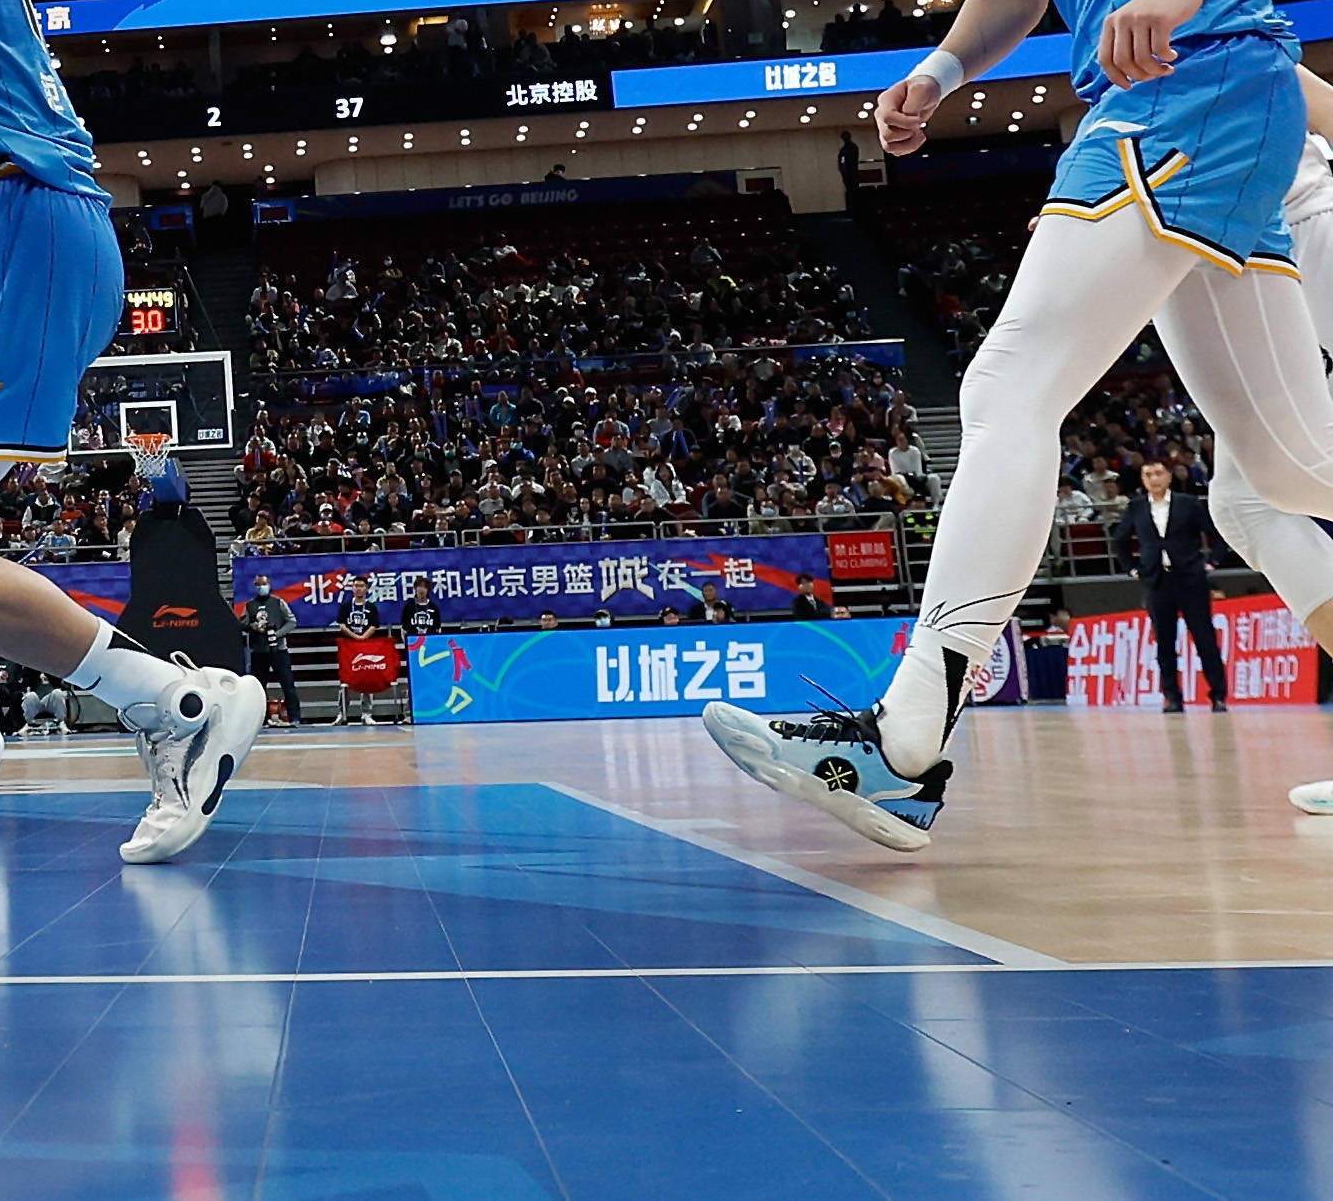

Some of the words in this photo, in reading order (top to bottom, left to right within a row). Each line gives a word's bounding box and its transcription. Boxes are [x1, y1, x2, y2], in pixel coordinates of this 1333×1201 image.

[505, 79, 598, 106] 北京控股
[208, 107, 221, 126] 2
[336, 98, 364, 118] 37
[153, 617, 200, 629] LI-NING
[596, 641, 767, 702] 以城之名
